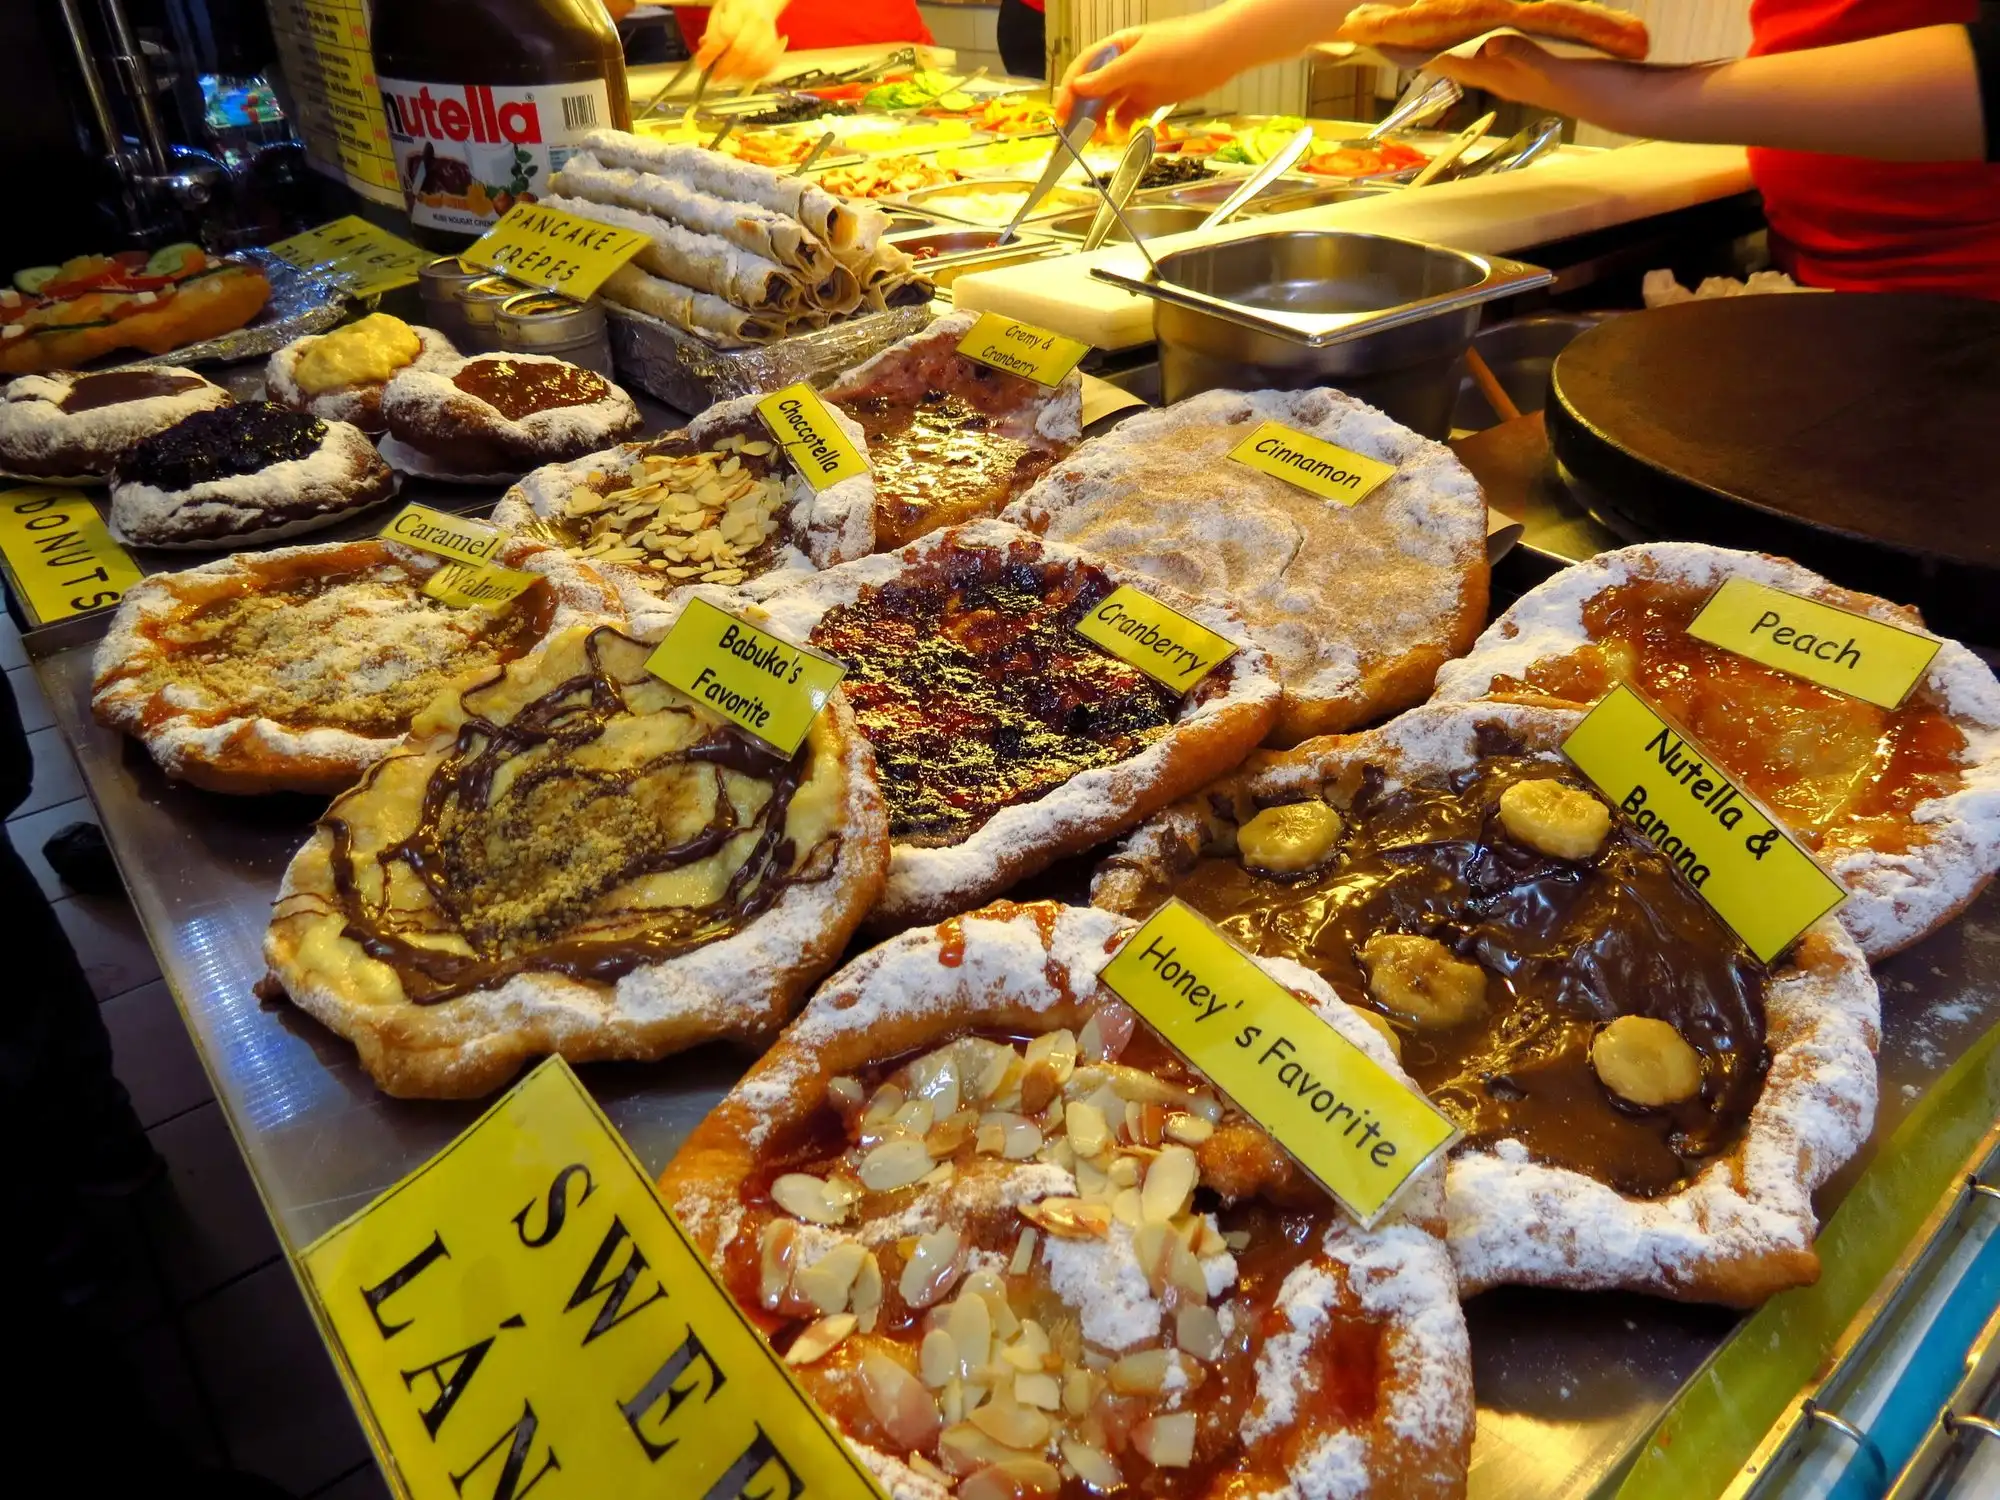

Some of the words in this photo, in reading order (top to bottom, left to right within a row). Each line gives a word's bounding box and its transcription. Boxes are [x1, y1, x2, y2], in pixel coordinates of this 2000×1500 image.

[382, 85, 542, 144] nutella
[506, 208, 617, 251] PANCAKE
[981, 345, 1040, 378] Cranberry
[1005, 325, 1042, 350] Cremy
[1041, 336, 1056, 352] &
[778, 399, 841, 474] Choccotella
[1255, 438, 1362, 489] Cinnamon
[13, 496, 120, 611] DONUTS
[394, 513, 500, 558] Caramel
[718, 623, 803, 685] Babuka's
[1097, 603, 1208, 677] Cranberry
[1749, 610, 1862, 670] Peach
[691, 667, 771, 729] Favorite
[1645, 727, 1744, 832] Nutella
[1745, 829, 1780, 861] &
[1621, 784, 1711, 889] Banana
[1257, 1036, 1398, 1169] Favorite
